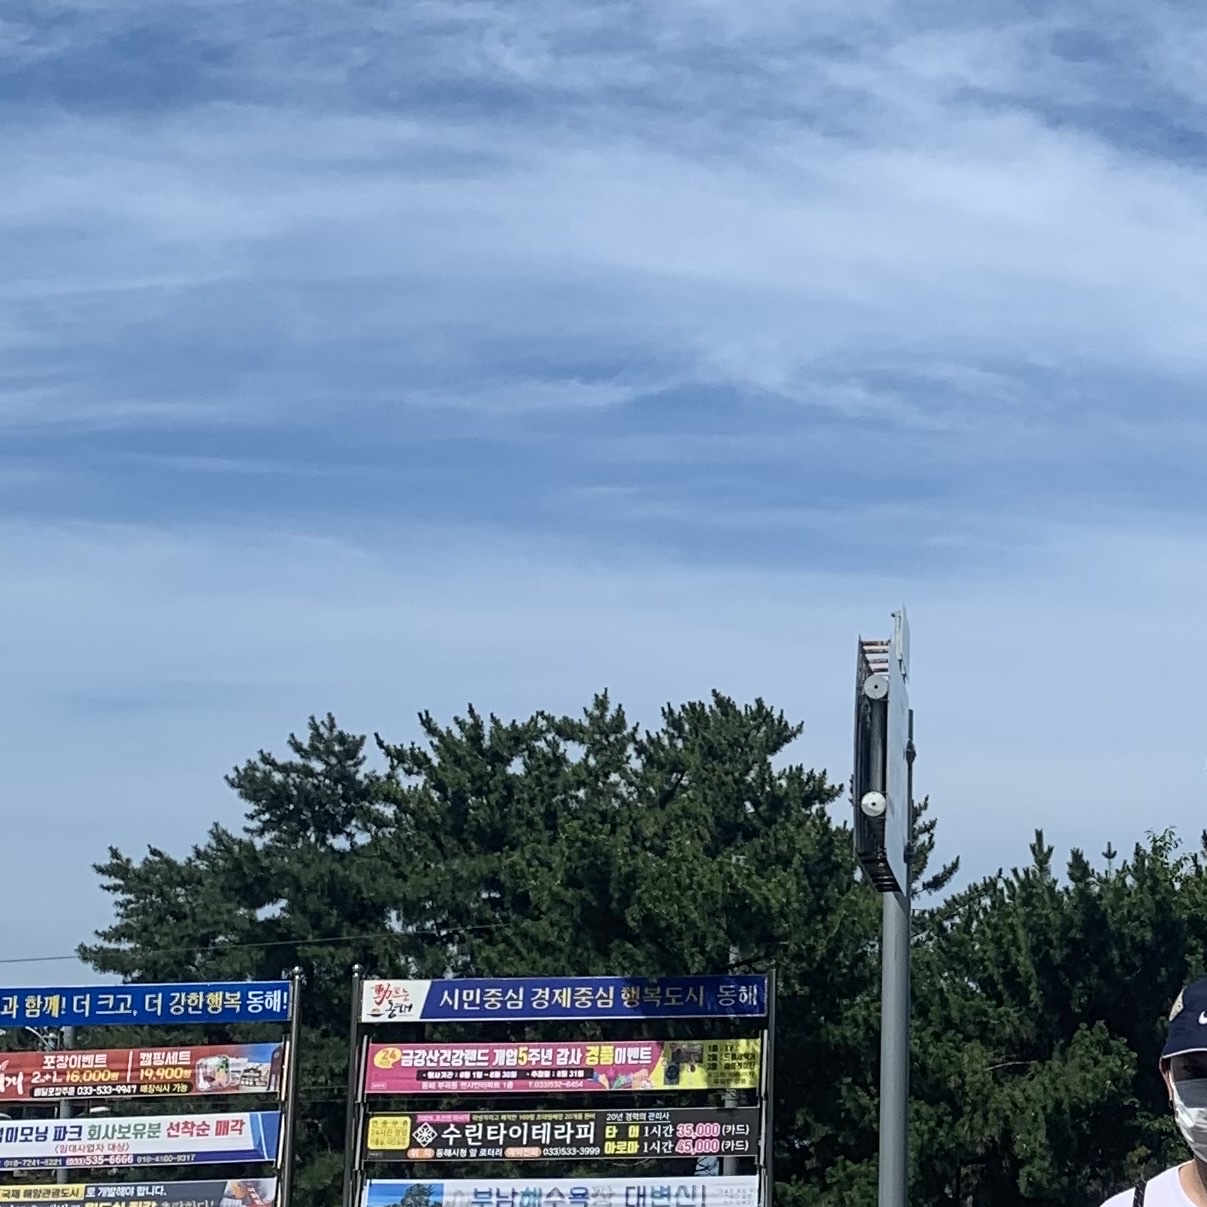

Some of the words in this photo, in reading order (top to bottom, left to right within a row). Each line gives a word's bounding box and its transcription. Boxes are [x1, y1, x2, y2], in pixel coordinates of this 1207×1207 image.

[25, 994, 66, 1018] 함께!
[73, 993, 91, 1017] 더
[96, 994, 138, 1017] 크고,
[144, 992, 163, 1016] 더
[246, 989, 288, 1013] 동해!
[439, 987, 524, 1010] 시민중심
[531, 986, 614, 1009] 경제중심
[621, 985, 704, 1008] 행복도시
[716, 984, 758, 1007] 동해
[42, 1053, 107, 1069] 포장이벤트
[140, 1051, 191, 1066] 캠핑세트
[400, 1049, 489, 1067] 금강산건강랜드
[492, 1047, 553, 1066] 개업5주년
[556, 1048, 582, 1065] 감사
[586, 1046, 652, 1066] 경품이벤트
[52, 1125, 83, 1141] 파크
[87, 1122, 161, 1140] 회사보유분
[167, 1120, 210, 1138] 선착순
[215, 1119, 245, 1136] 매각
[441, 1122, 595, 1146] 수린타이테라피
[643, 1124, 675, 1138] 1시간
[675, 1122, 721, 1140] 35,000
[722, 1123, 750, 1136] (카드)
[604, 1140, 640, 1154] 아로마
[643, 1139, 674, 1154] 1시간
[675, 1139, 720, 1155] 45,000
[721, 1139, 750, 1152] (카드)
